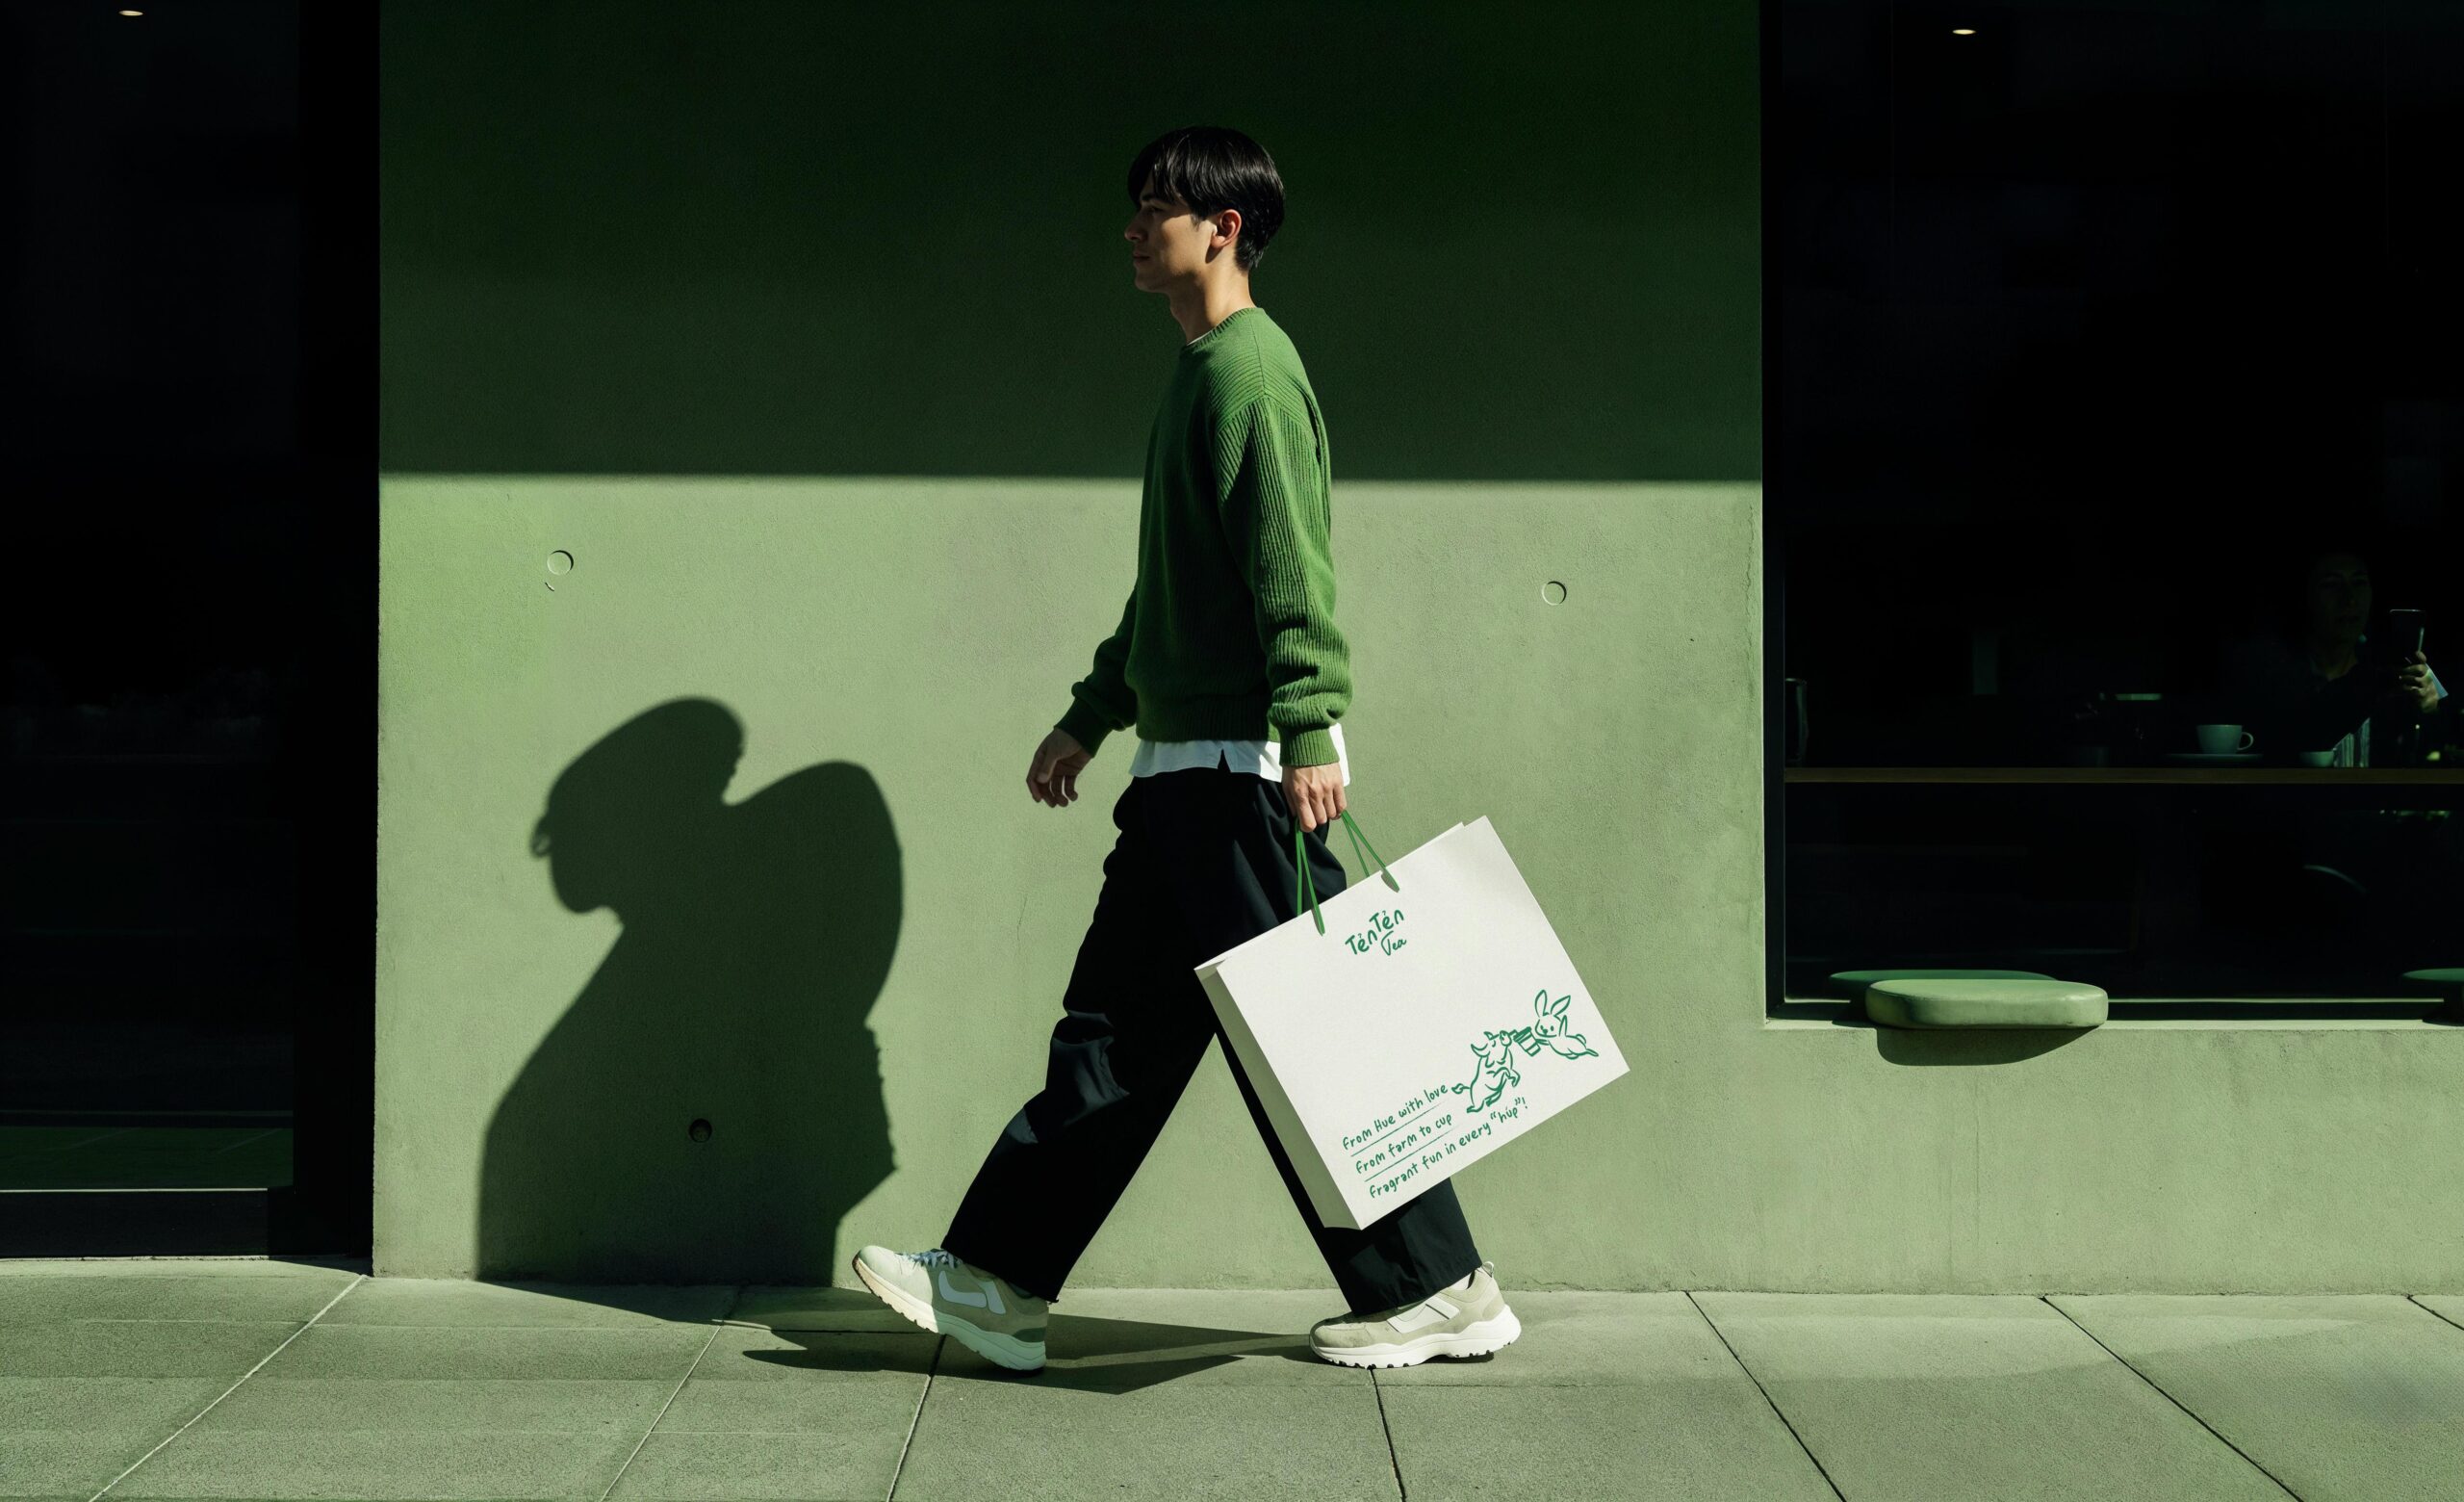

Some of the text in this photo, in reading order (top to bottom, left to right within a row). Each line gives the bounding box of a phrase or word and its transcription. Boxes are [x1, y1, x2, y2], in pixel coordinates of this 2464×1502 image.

[1380, 930, 1407, 956] Tea
[1373, 1115, 1396, 1132] Hue
[1399, 1098, 1424, 1118] with
[1424, 1084, 1449, 1103] love
[1388, 1134, 1418, 1157] farm
[1419, 1125, 1432, 1138] to
[1435, 1114, 1452, 1130] cup
[1422, 1151, 1443, 1170] fun
[1444, 1143, 1457, 1155] in
[1459, 1122, 1492, 1147] every
